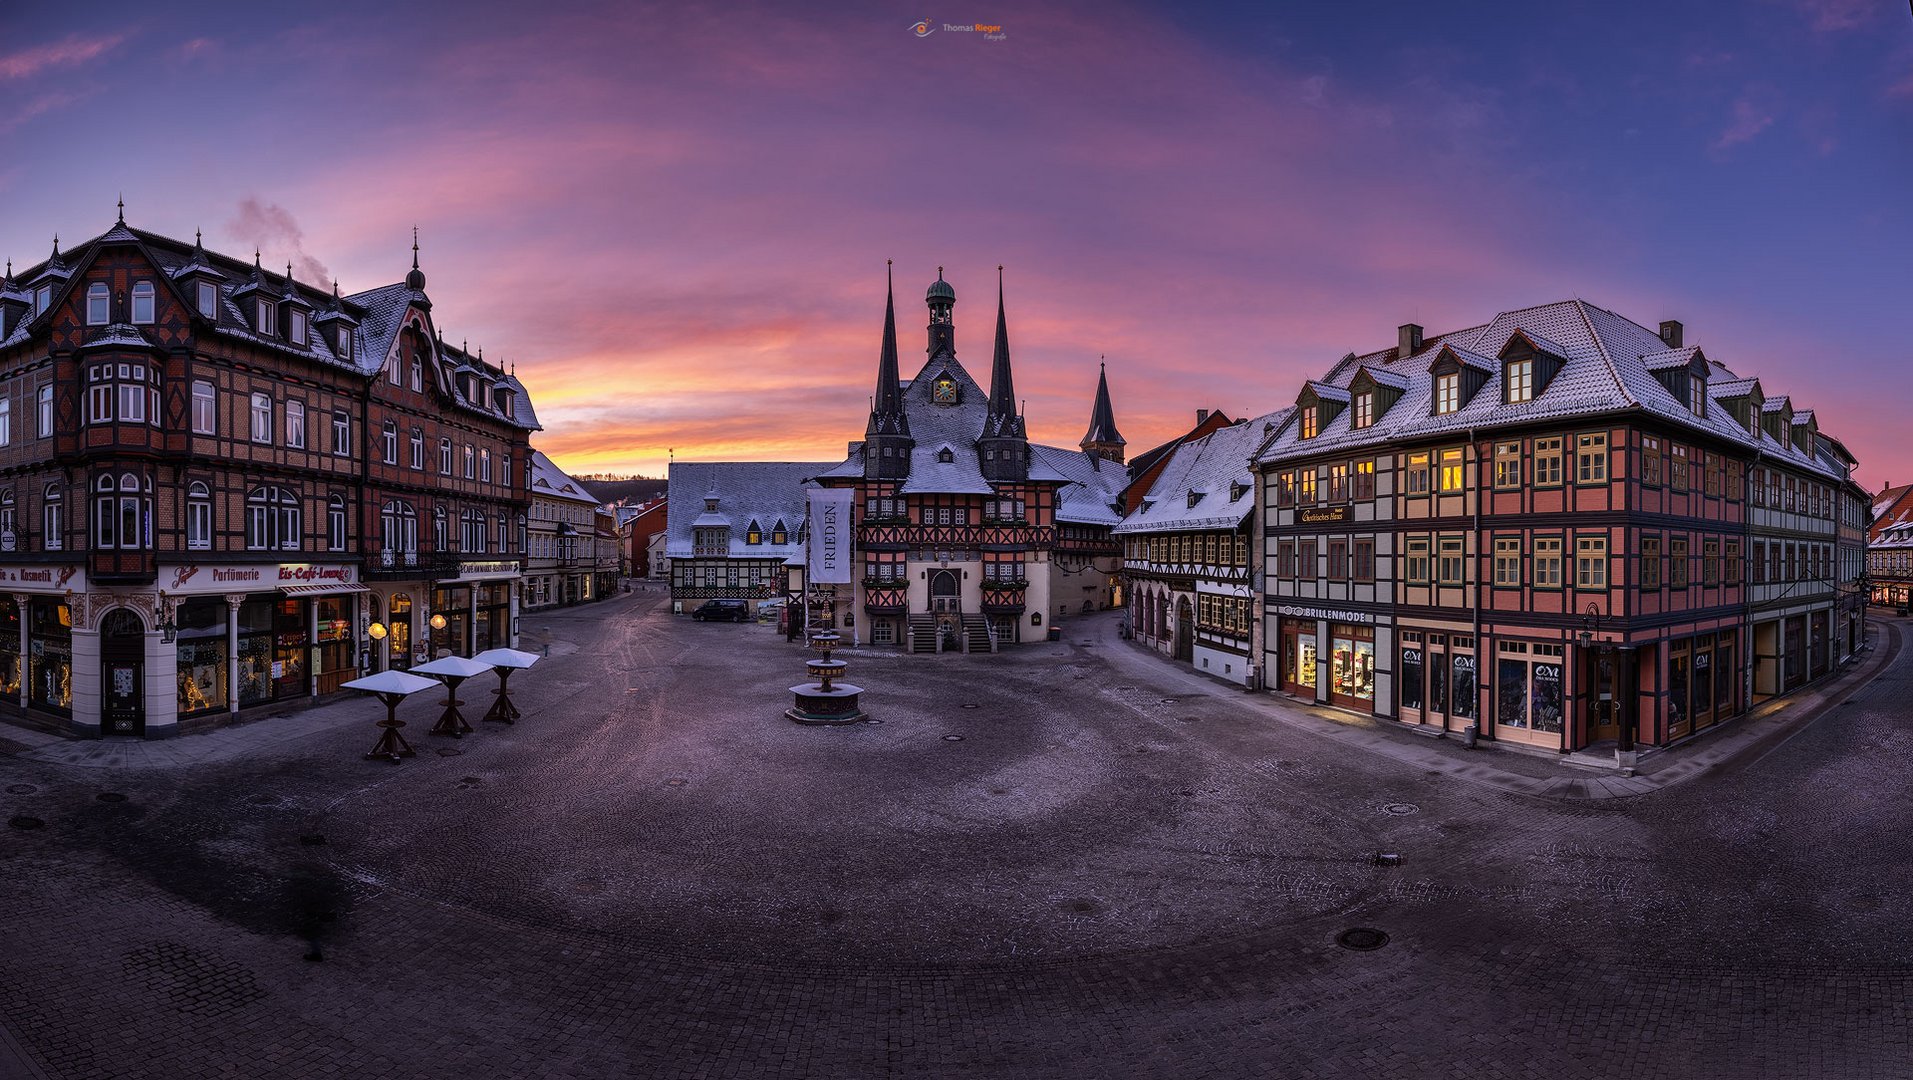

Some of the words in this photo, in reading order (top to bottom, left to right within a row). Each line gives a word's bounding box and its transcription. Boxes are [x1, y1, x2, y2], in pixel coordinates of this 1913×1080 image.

[825, 501, 837, 570] FRIEDEN.
[20, 568, 52, 582] Kosmetik
[213, 568, 260, 582] Parfümerie
[1305, 607, 1366, 622] BRILLENMODE
[1535, 665, 1559, 677] OM
